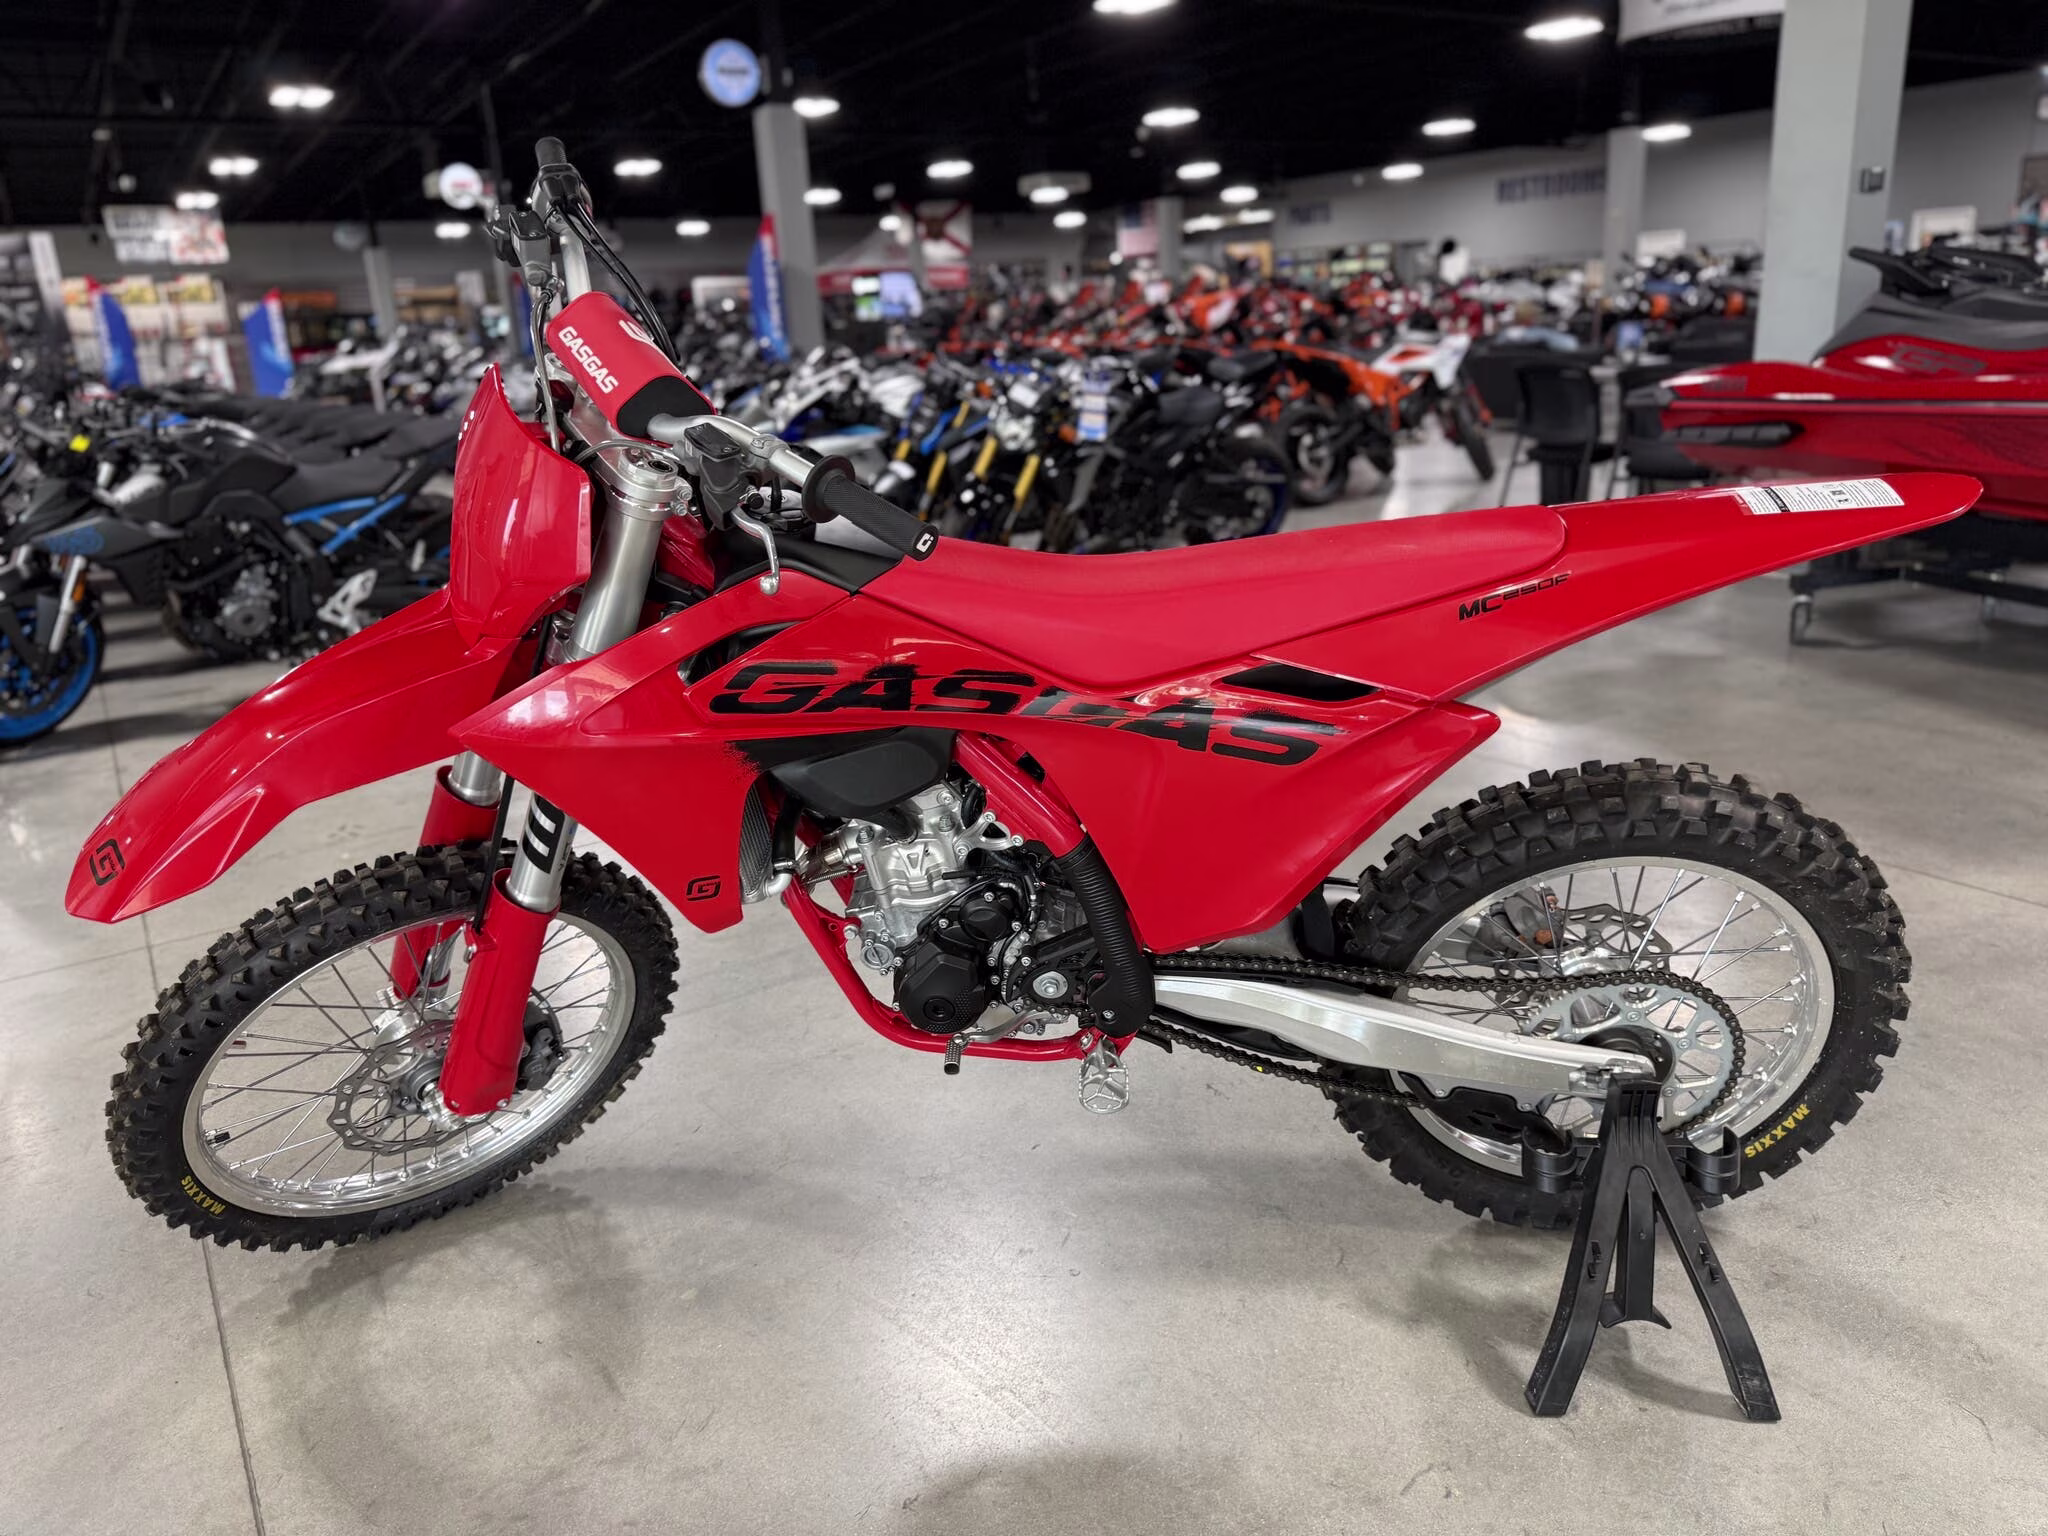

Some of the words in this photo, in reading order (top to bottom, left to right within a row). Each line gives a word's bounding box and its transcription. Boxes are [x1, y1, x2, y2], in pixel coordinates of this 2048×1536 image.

[558, 326, 619, 394] GASGAS
[708, 659, 1350, 767] GASGAS
[1744, 1103, 1811, 1158] MAXXIS
[181, 1175, 226, 1215] MAXXIS
